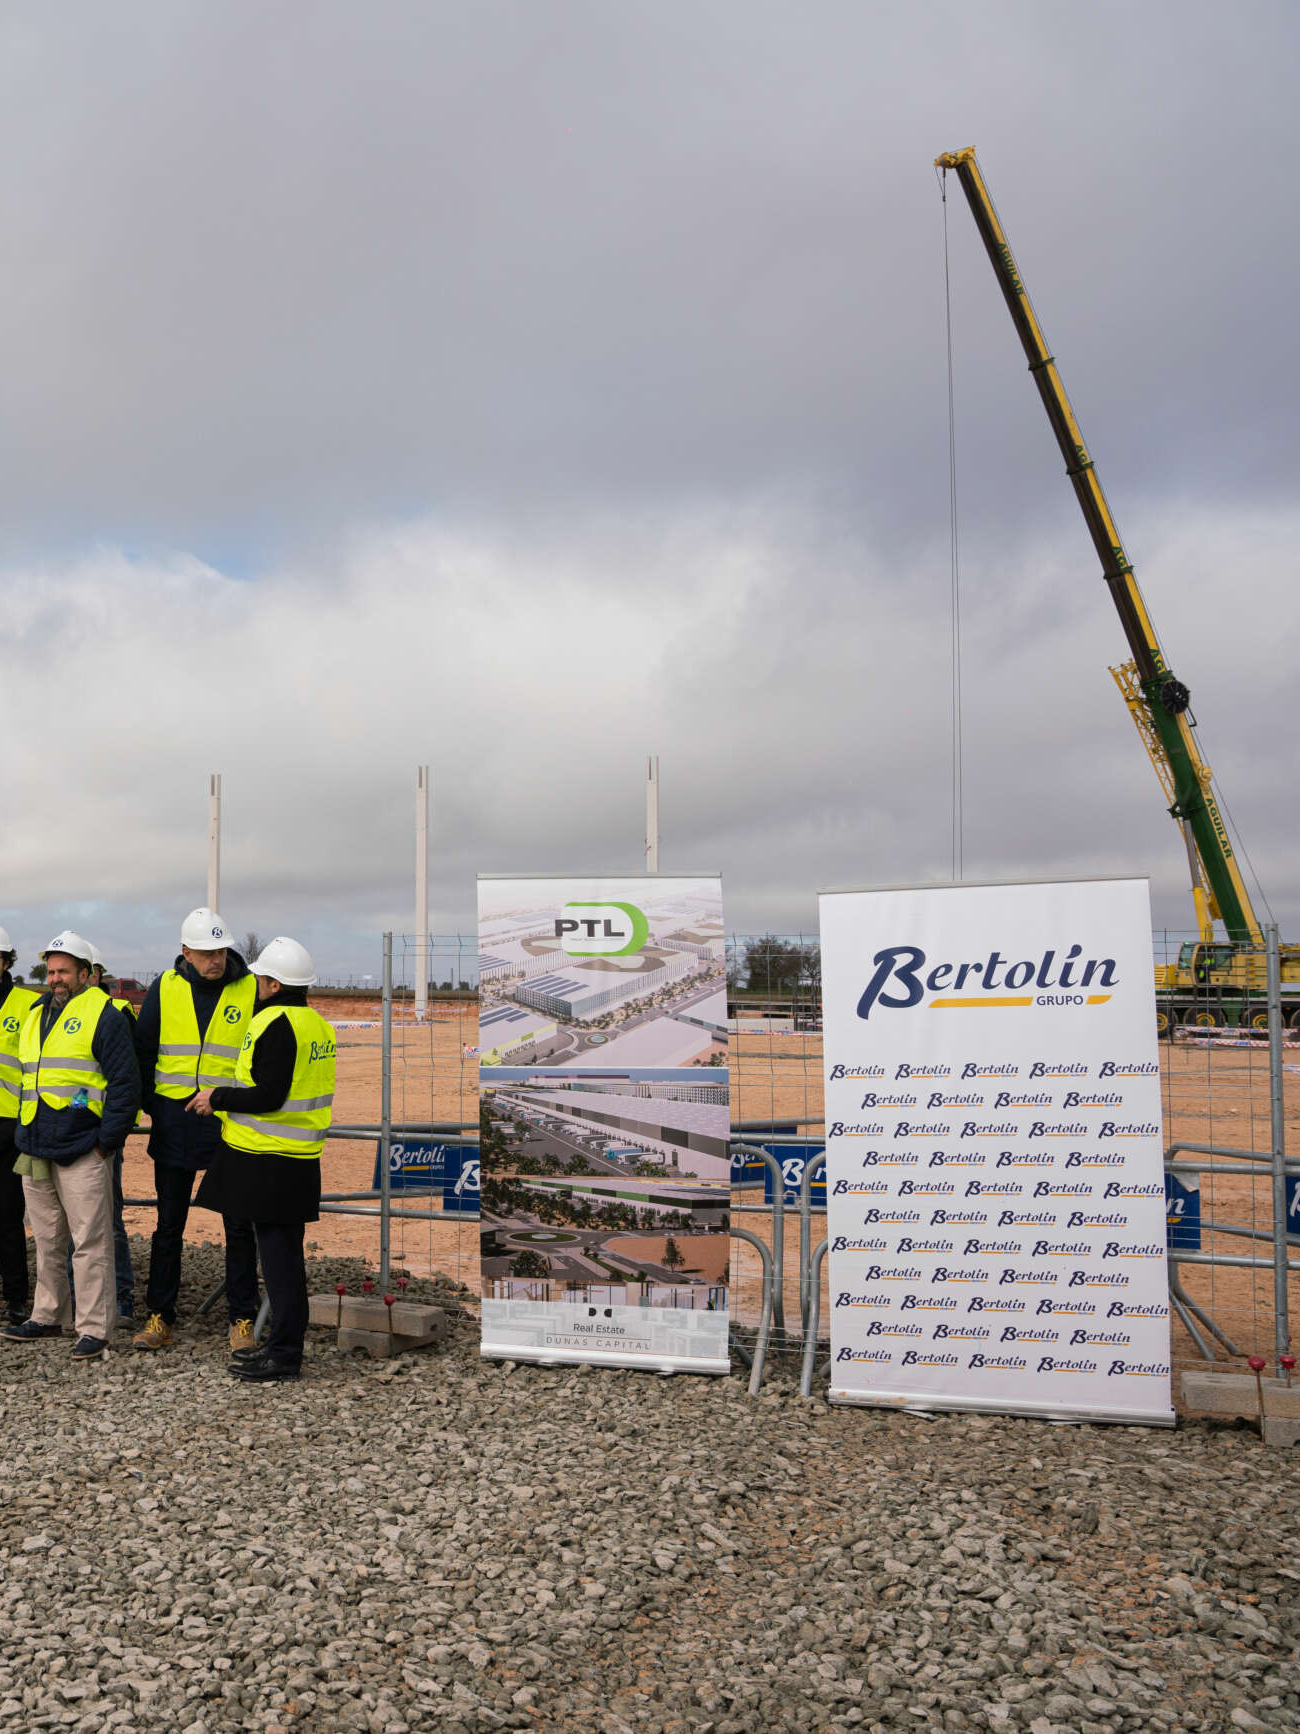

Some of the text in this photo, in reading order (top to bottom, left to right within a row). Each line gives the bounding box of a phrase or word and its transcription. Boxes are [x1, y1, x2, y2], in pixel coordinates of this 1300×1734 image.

[1205, 797, 1233, 860] AGUILAR
[554, 919, 625, 937] PTL
[856, 943, 1120, 1020] Bertolín
[1036, 995, 1084, 1006] GRUPO
[829, 1064, 885, 1081] Bertolín
[894, 1063, 951, 1081] Bertolín
[960, 1062, 1019, 1080] Bertolín
[1028, 1062, 1088, 1080] Bertolín
[860, 1091, 1123, 1110] Bertolín Bertolín Bertolín Bertolín
[828, 1121, 884, 1139] Bertolín
[893, 1121, 951, 1139] Bertolín
[959, 1121, 1019, 1139] Bertolín
[1028, 1121, 1088, 1140] Bertolín
[390, 1144, 445, 1171] Bertolí
[862, 1150, 1126, 1170] Bertolín Bertolín Bertolín Bertolín
[833, 1179, 888, 1196] Bertolín
[897, 1180, 955, 1197] Bertolín
[964, 1180, 1023, 1198] Bertolín
[1032, 1180, 1093, 1199] Bertolín
[863, 1208, 1128, 1229] Bertolín Bertolín Bertolín Bertolín
[831, 1236, 887, 1253] Bertolín
[896, 1237, 954, 1255] Bertolín
[963, 1238, 1022, 1257] Bertolín
[1031, 1240, 1092, 1258] Bertolín
[864, 1265, 1130, 1289] Bertolín Bertolín Bertolín Bertolín
[834, 1292, 891, 1309] Bertolín
[900, 1294, 958, 1311] Bertolín
[966, 1296, 1026, 1314] Bertolín
[1035, 1298, 1096, 1316] Bertolín
[573, 1323, 626, 1335] Real Estate
[866, 1321, 1131, 1347] Bertolín Bertolín Bertolín Bertolín
[546, 1336, 652, 1350] DUNAS CAPITAL
[836, 1346, 892, 1363] Bertolín
[901, 1350, 959, 1367] Bertolín
[967, 1353, 1027, 1370] Bertolín
[1036, 1356, 1097, 1374] Bertolín
